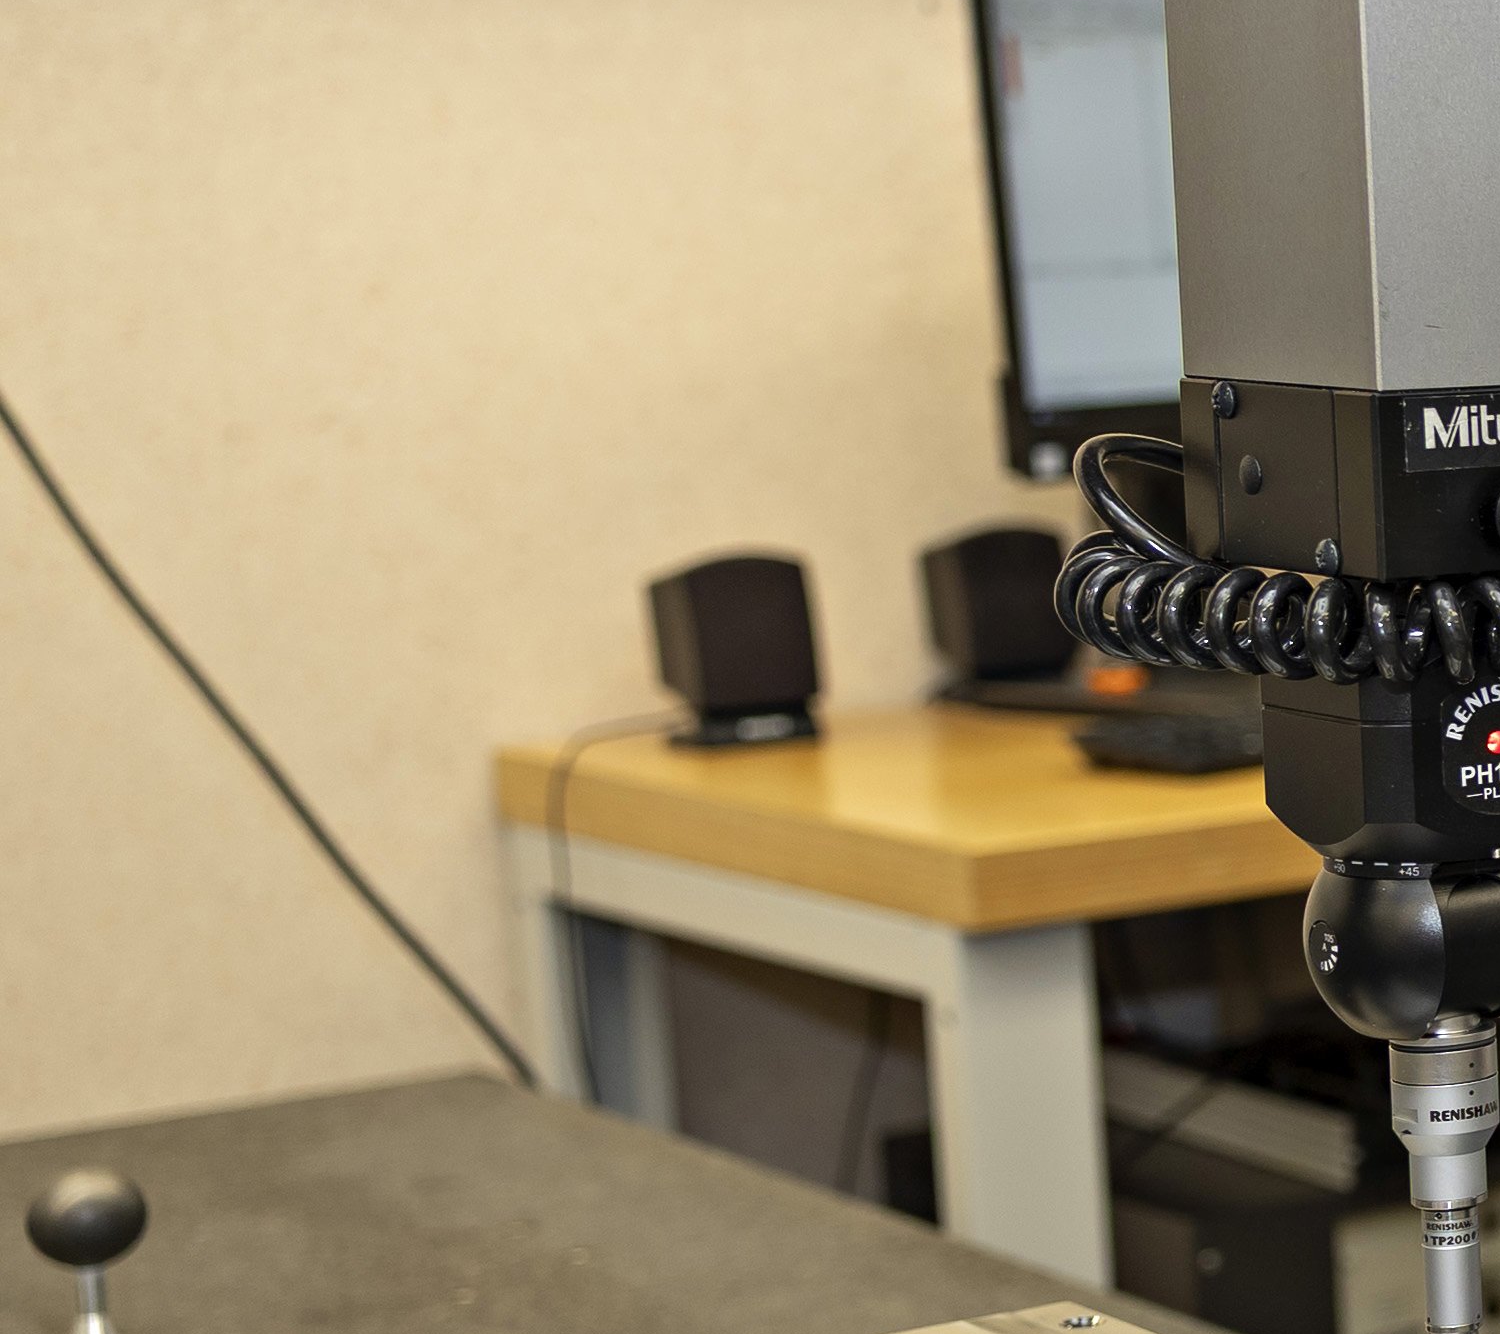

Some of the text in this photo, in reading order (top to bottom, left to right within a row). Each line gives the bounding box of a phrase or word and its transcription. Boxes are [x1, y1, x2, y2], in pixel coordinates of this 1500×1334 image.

[1399, 867, 1420, 877] +45
[1426, 1220, 1472, 1231] RENISHAW
[1430, 1233, 1471, 1246] TP200
